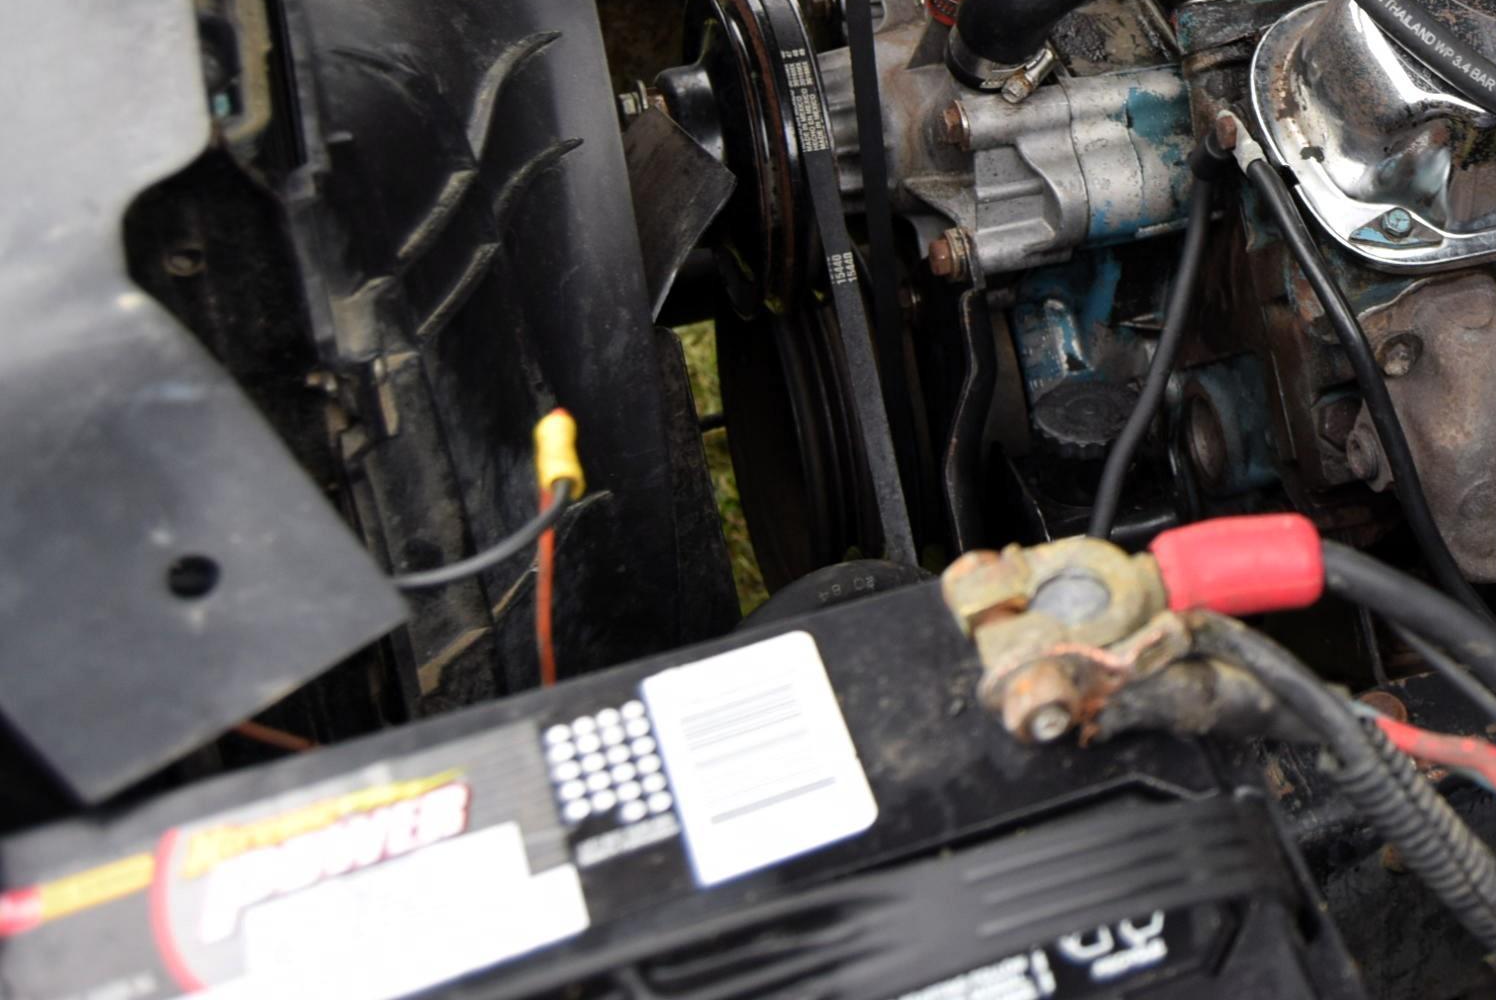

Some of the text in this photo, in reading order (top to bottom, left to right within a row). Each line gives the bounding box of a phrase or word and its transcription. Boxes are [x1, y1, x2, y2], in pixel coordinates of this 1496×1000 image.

[1434, 38, 1455, 59] WP
[1452, 53, 1471, 73] 3.4
[1469, 66, 1496, 92] BAR
[831, 253, 846, 284] 15440
